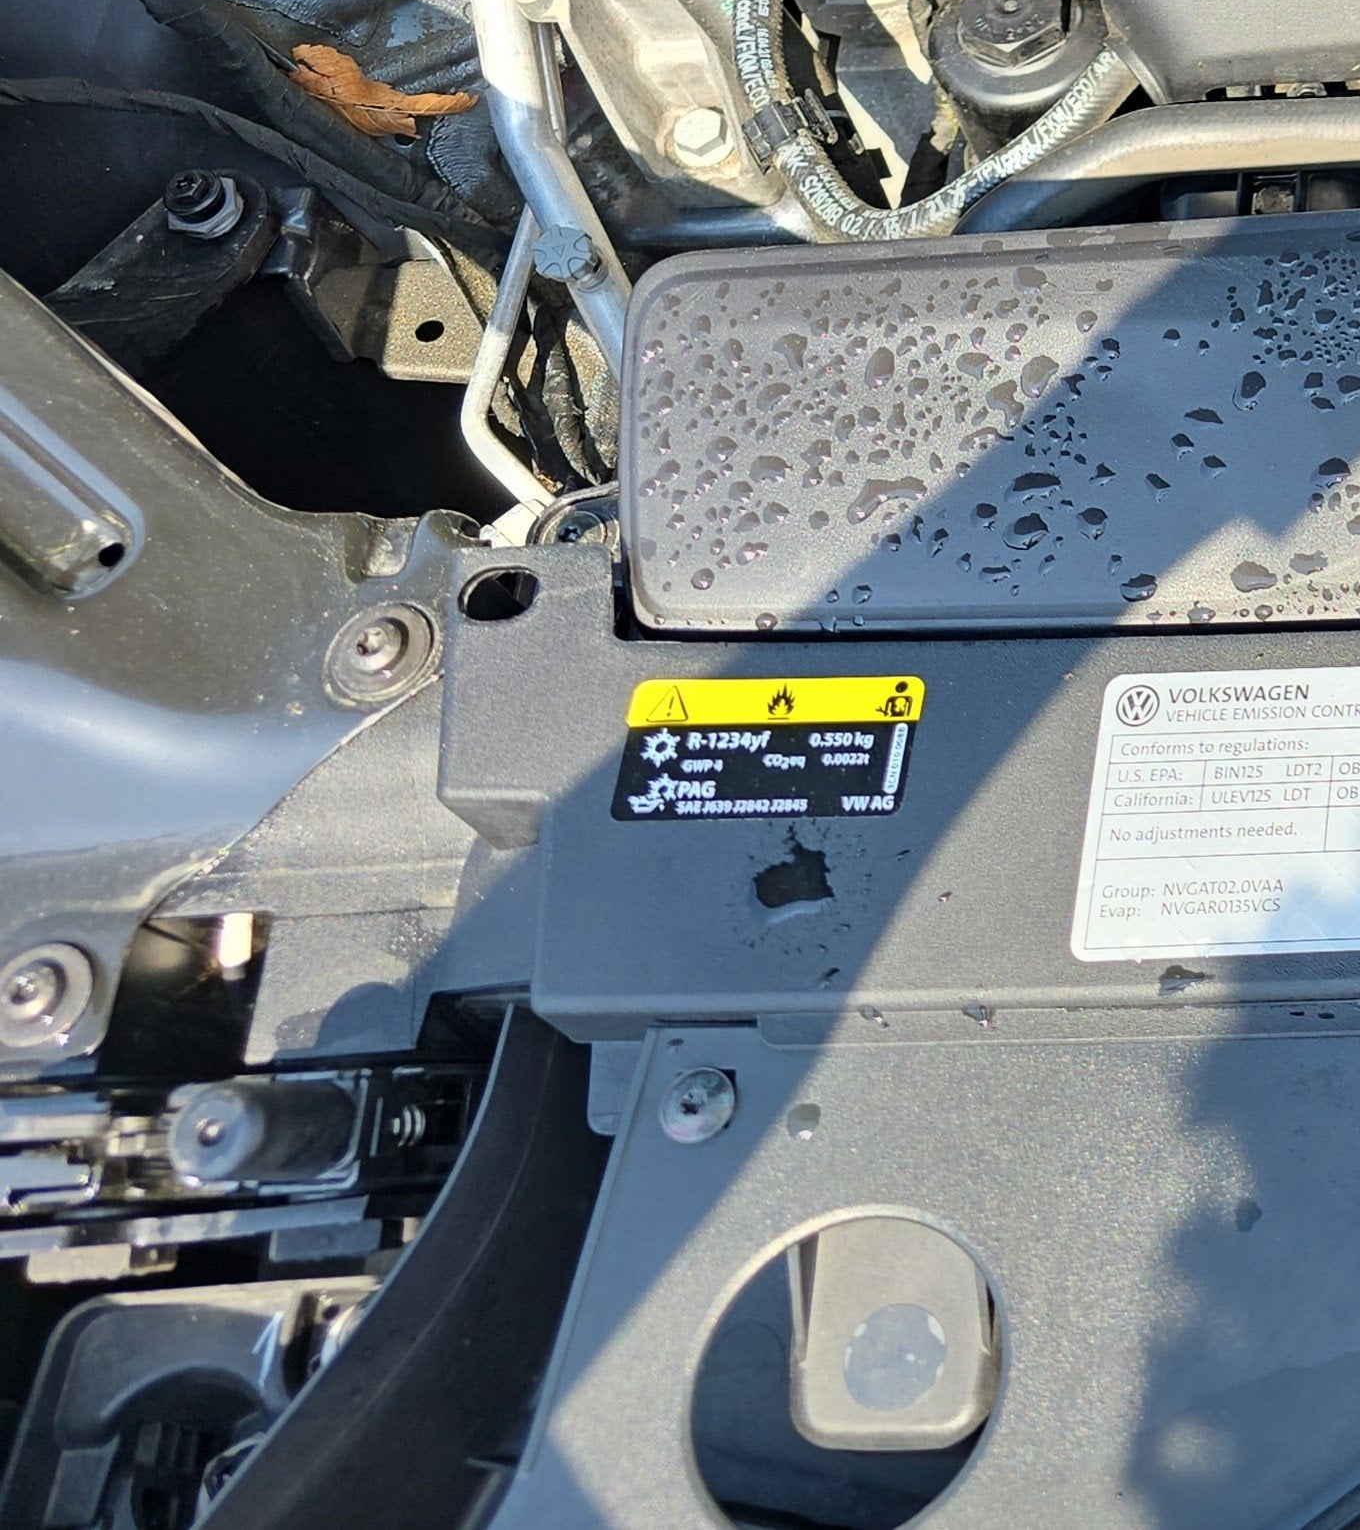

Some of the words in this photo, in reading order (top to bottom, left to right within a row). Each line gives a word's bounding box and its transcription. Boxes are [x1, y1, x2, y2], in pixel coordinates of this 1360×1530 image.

[1168, 684, 1310, 704] VOLKSWAGEN
[1165, 707, 1228, 723] VEHICLE
[1232, 705, 1307, 721] EMISSION
[1121, 741, 1194, 757] Conforms
[1198, 741, 1215, 754] to
[1218, 737, 1309, 756] regulations:
[1117, 769, 1145, 783] U.S.
[1149, 767, 1183, 782] EPA:
[1214, 764, 1263, 780] BIN125
[1285, 762, 1323, 777] LDT2
[1113, 791, 1193, 808] California:
[1211, 788, 1272, 805] ULEV125
[1283, 787, 1312, 802] LDT
[1109, 828, 1132, 842] No
[1135, 825, 1233, 843] adjustments
[1237, 821, 1297, 838] needed.
[1102, 884, 1155, 901] Group:
[1099, 904, 1141, 921] Evap:
